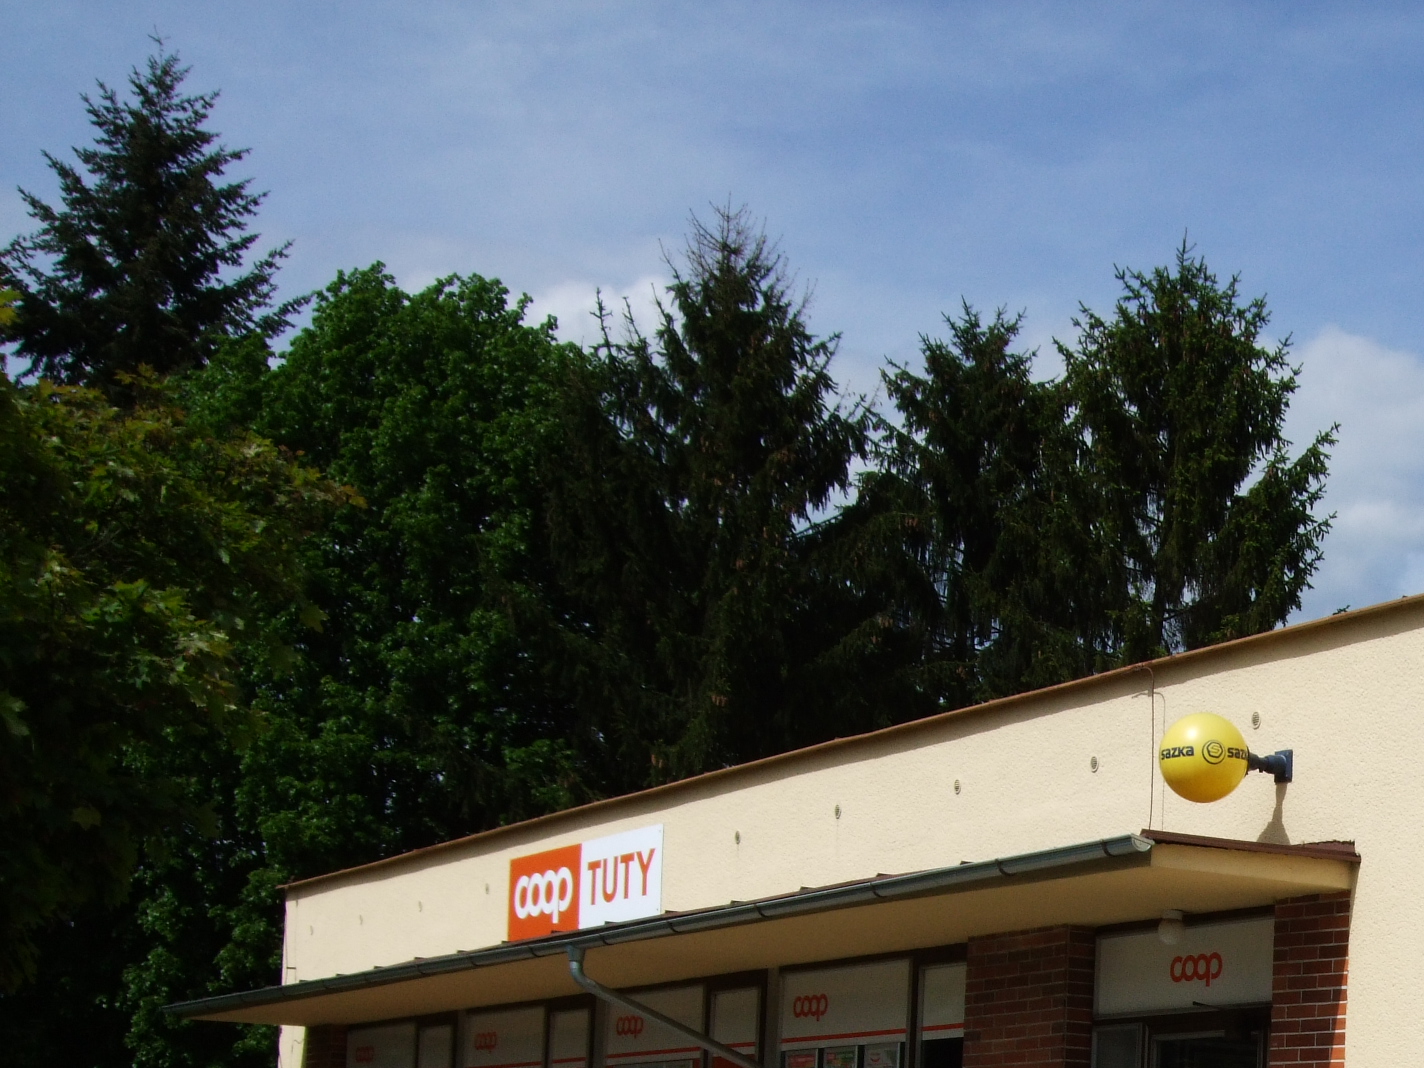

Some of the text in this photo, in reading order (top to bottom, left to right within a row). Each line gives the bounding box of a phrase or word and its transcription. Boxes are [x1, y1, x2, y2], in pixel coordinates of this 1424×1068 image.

[1227, 747, 1247, 760] saz
[514, 848, 656, 924] coop TUTY
[1169, 952, 1223, 987] coop
[793, 994, 828, 1021] coop
[616, 1015, 644, 1038] coop
